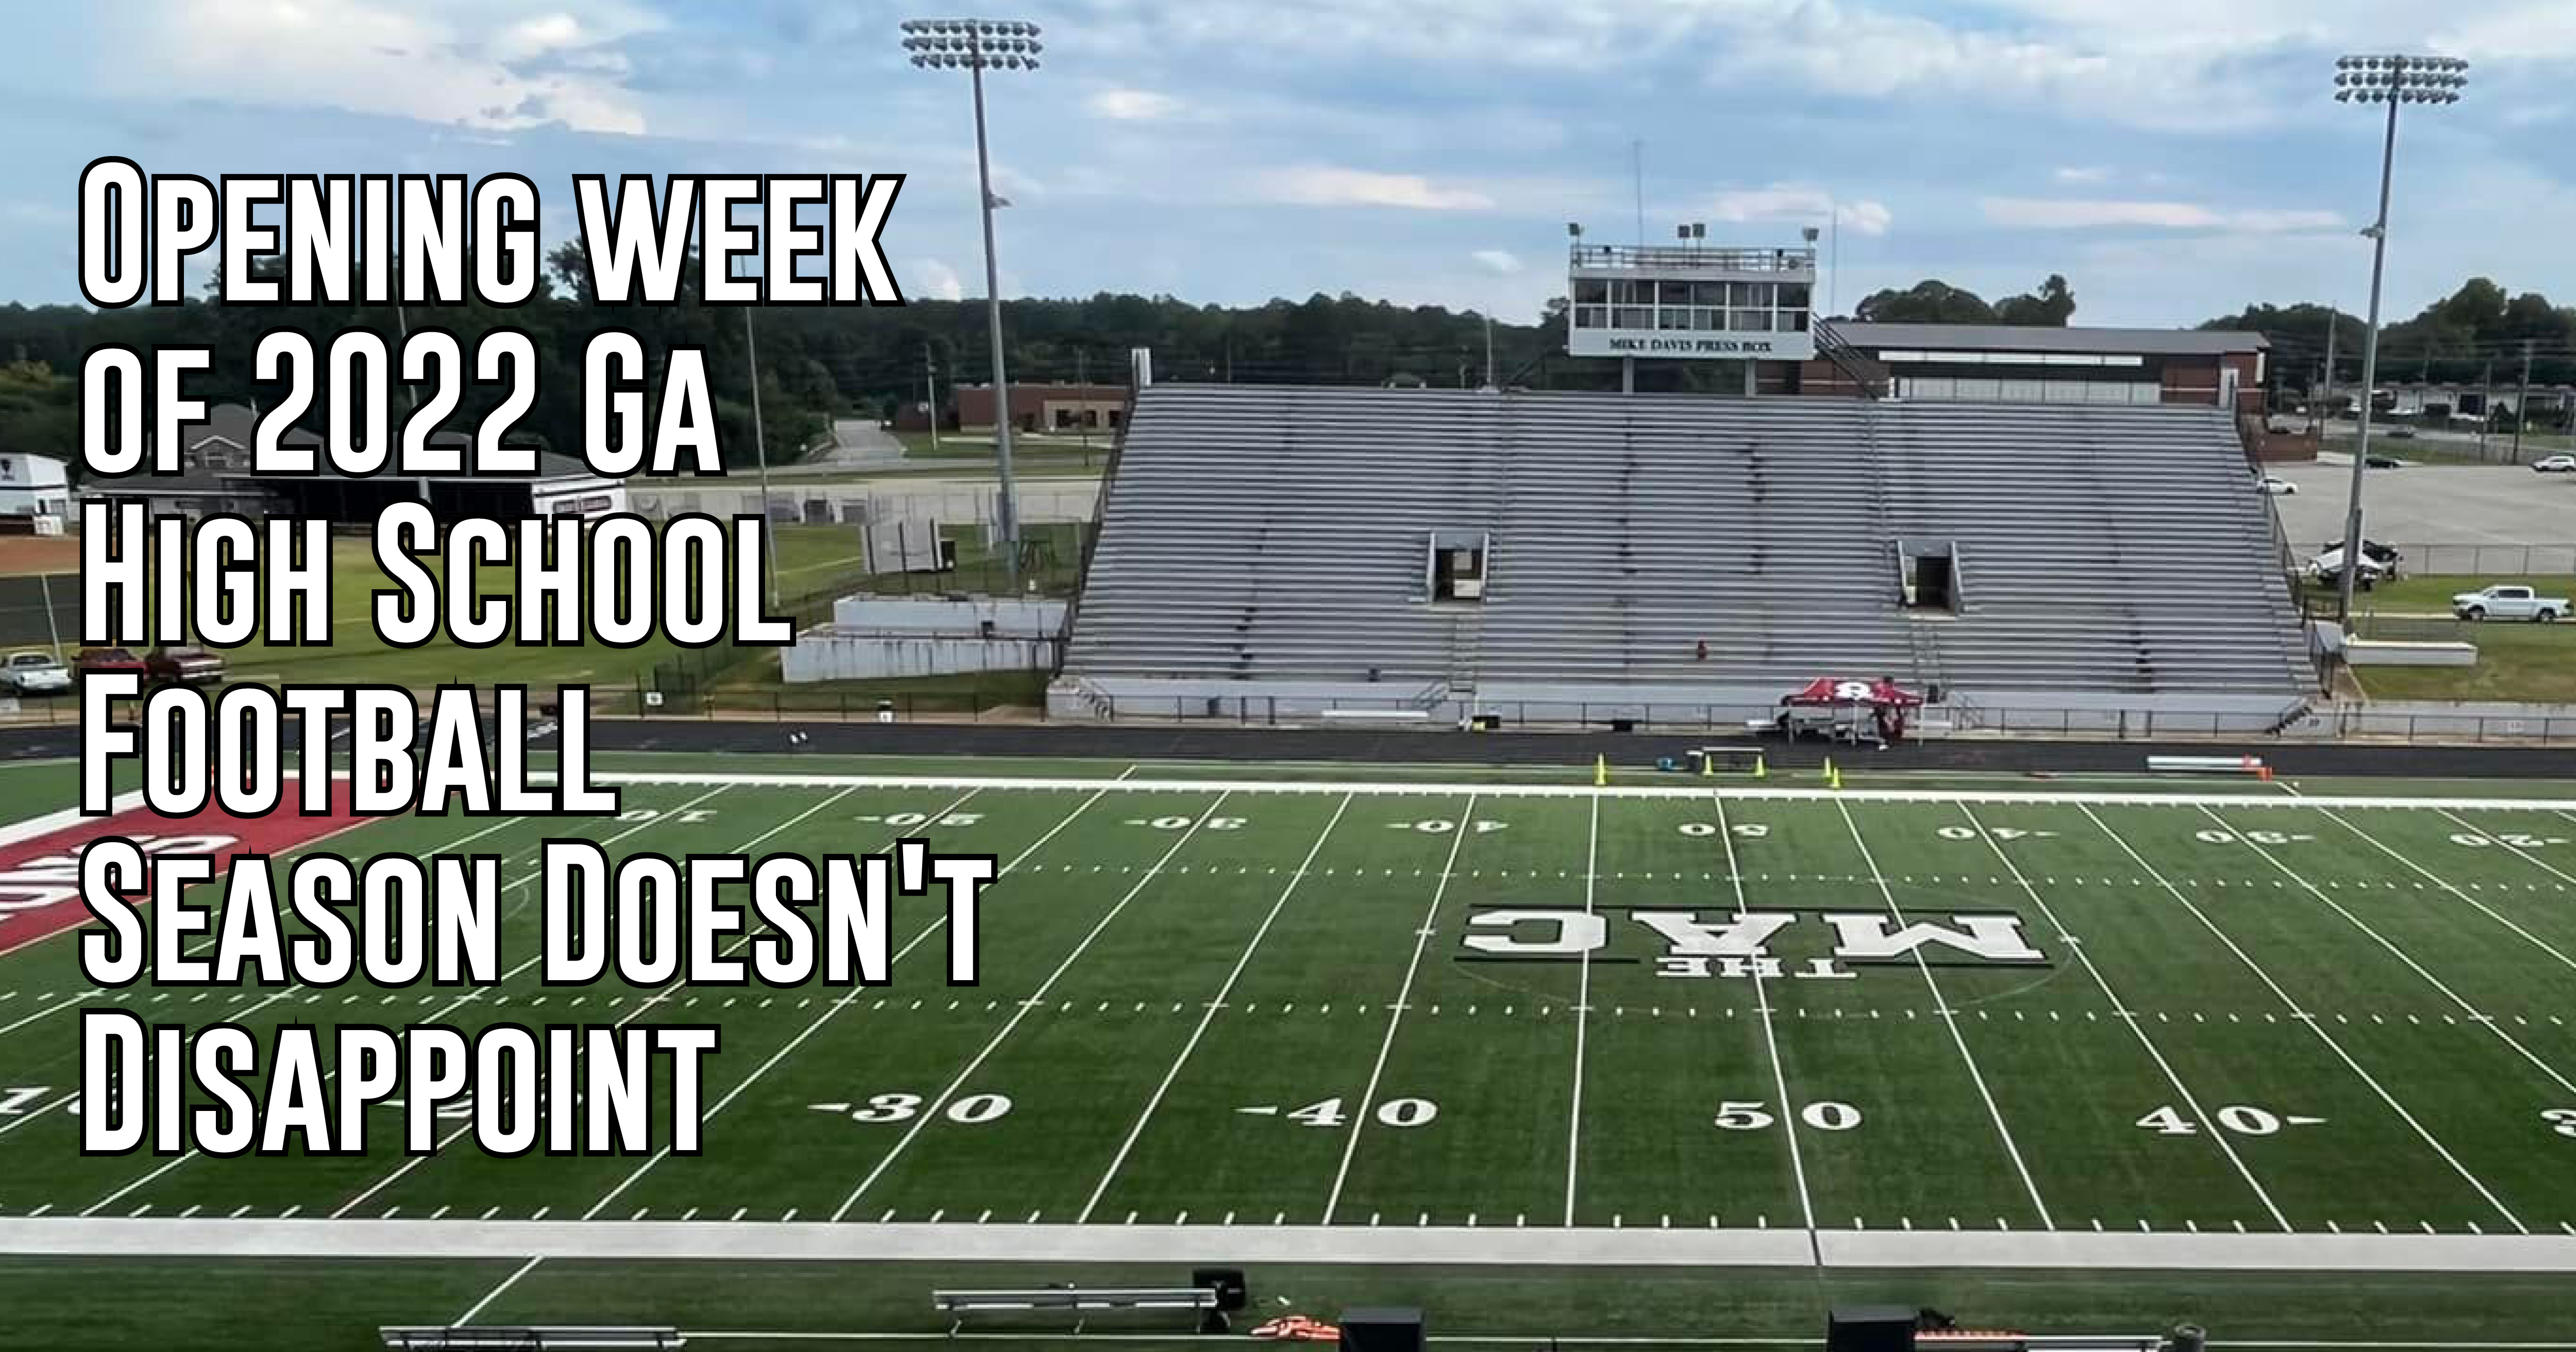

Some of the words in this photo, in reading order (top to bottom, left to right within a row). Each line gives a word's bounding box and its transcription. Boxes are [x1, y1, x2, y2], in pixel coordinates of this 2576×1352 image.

[1609, 338, 1647, 350] MIKE
[1650, 338, 1693, 352] DAVIS
[1696, 339, 1739, 352] PRESS
[1462, 909, 2046, 960] MAC
[1655, 955, 1858, 979] THE
[1714, 1101, 1863, 1131] 50
